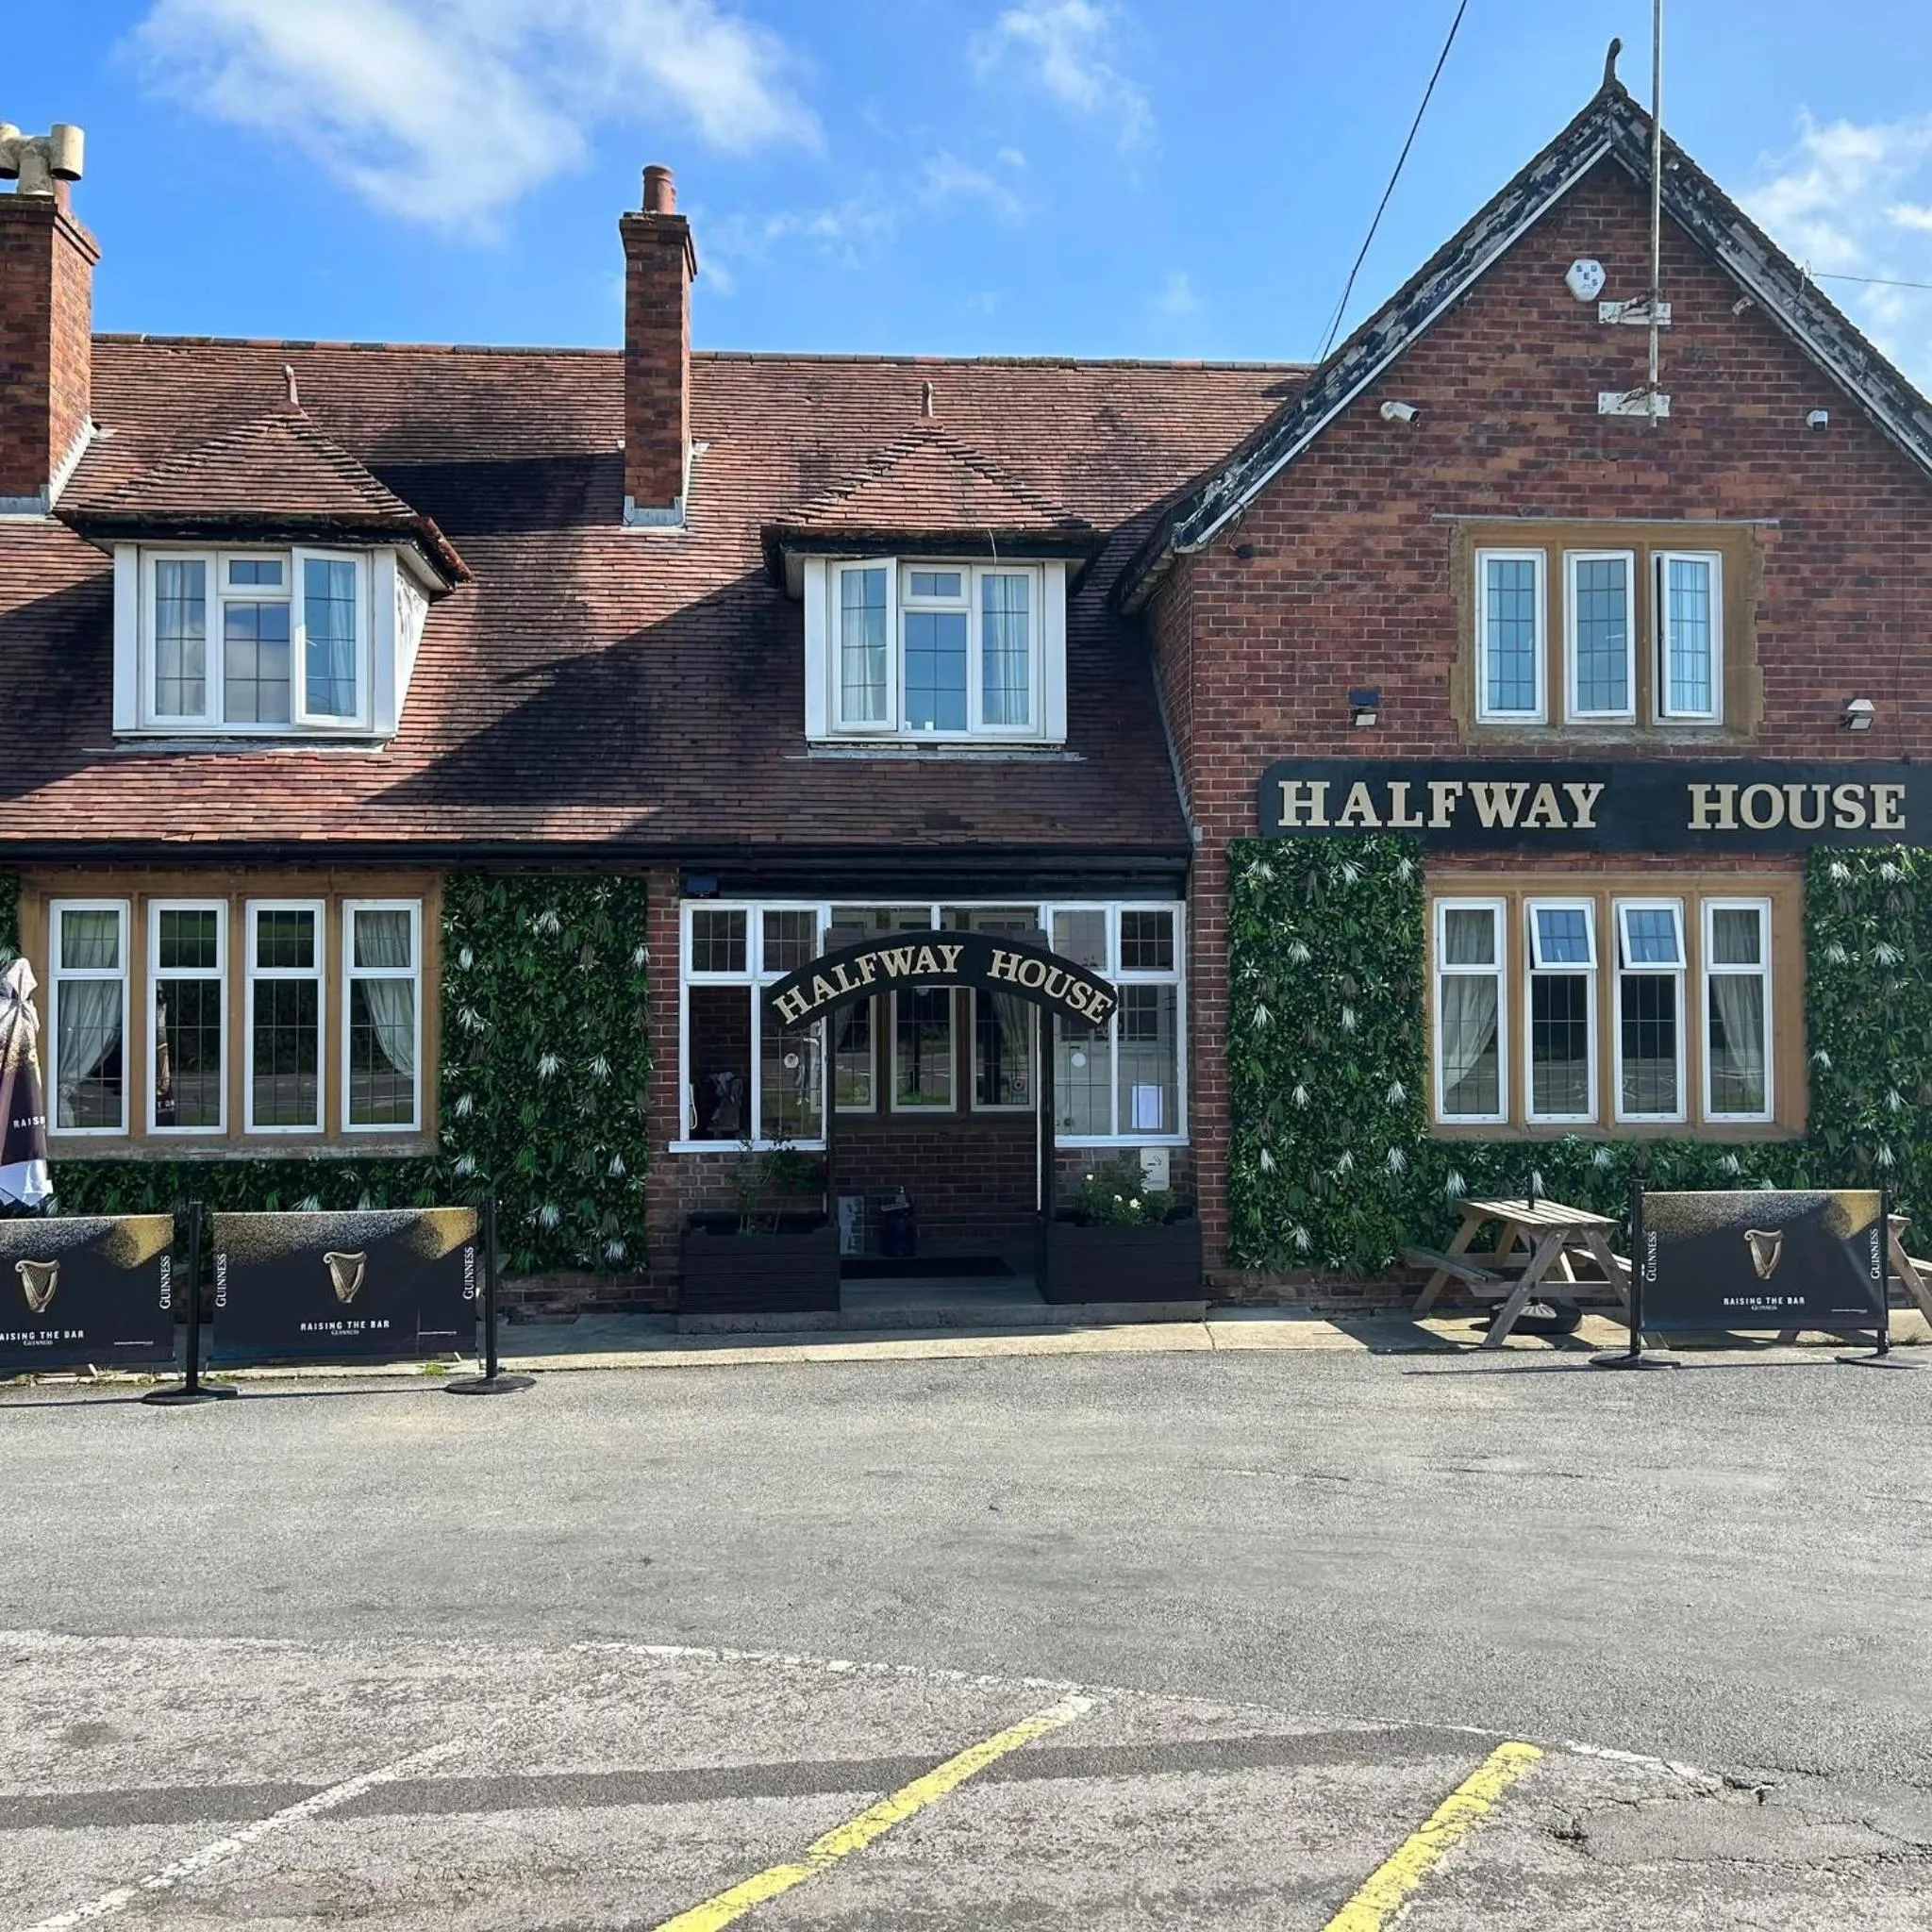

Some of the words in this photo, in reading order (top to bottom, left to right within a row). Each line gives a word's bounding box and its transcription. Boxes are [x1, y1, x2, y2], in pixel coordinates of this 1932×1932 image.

[1277, 779, 1605, 829] HALFWAY
[1687, 783, 1907, 831] HOUSE
[772, 944, 964, 1025] HALFWAY
[987, 948, 1114, 1024] HOUSE
[462, 1246, 475, 1300] GUINNESS
[1645, 1230, 1657, 1282] GUINNESS
[1870, 1228, 1880, 1279] GUINNESS
[158, 1255, 172, 1309] GUINNESS
[215, 1254, 227, 1307] GUINNESS
[1723, 1297, 1762, 1306] RAISING
[1766, 1296, 1783, 1305] THE
[1787, 1296, 1806, 1305] BAR
[0, 1331, 35, 1341] AISING
[40, 1331, 59, 1340] THE
[63, 1330, 84, 1339] BAR
[300, 1321, 342, 1331] RAISING
[346, 1321, 366, 1329] THE
[370, 1320, 390, 1329] BAR
